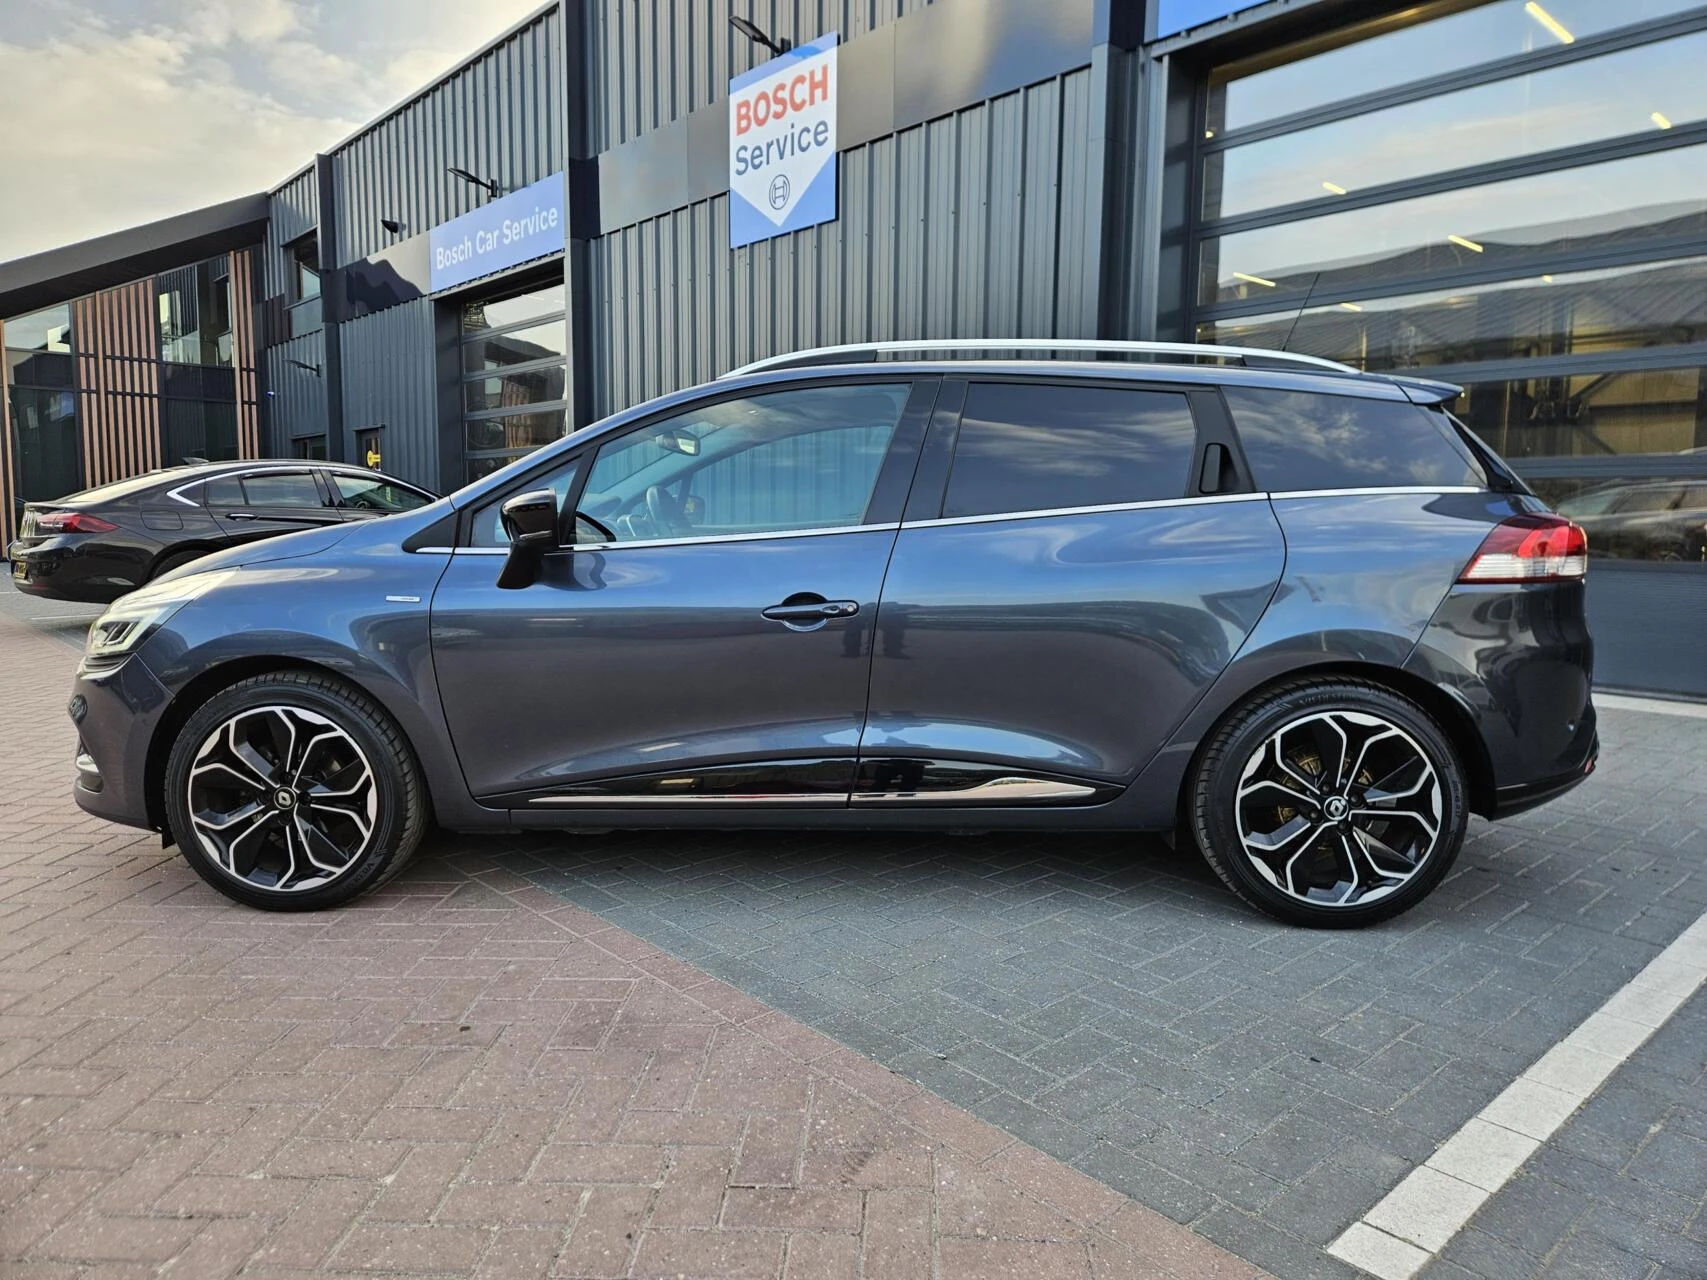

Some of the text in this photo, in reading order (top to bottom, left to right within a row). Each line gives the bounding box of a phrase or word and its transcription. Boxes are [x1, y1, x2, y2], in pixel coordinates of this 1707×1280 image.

[736, 64, 828, 136] BOSCH
[735, 120, 829, 176] Service
[436, 206, 558, 270] Bosch Car Service
